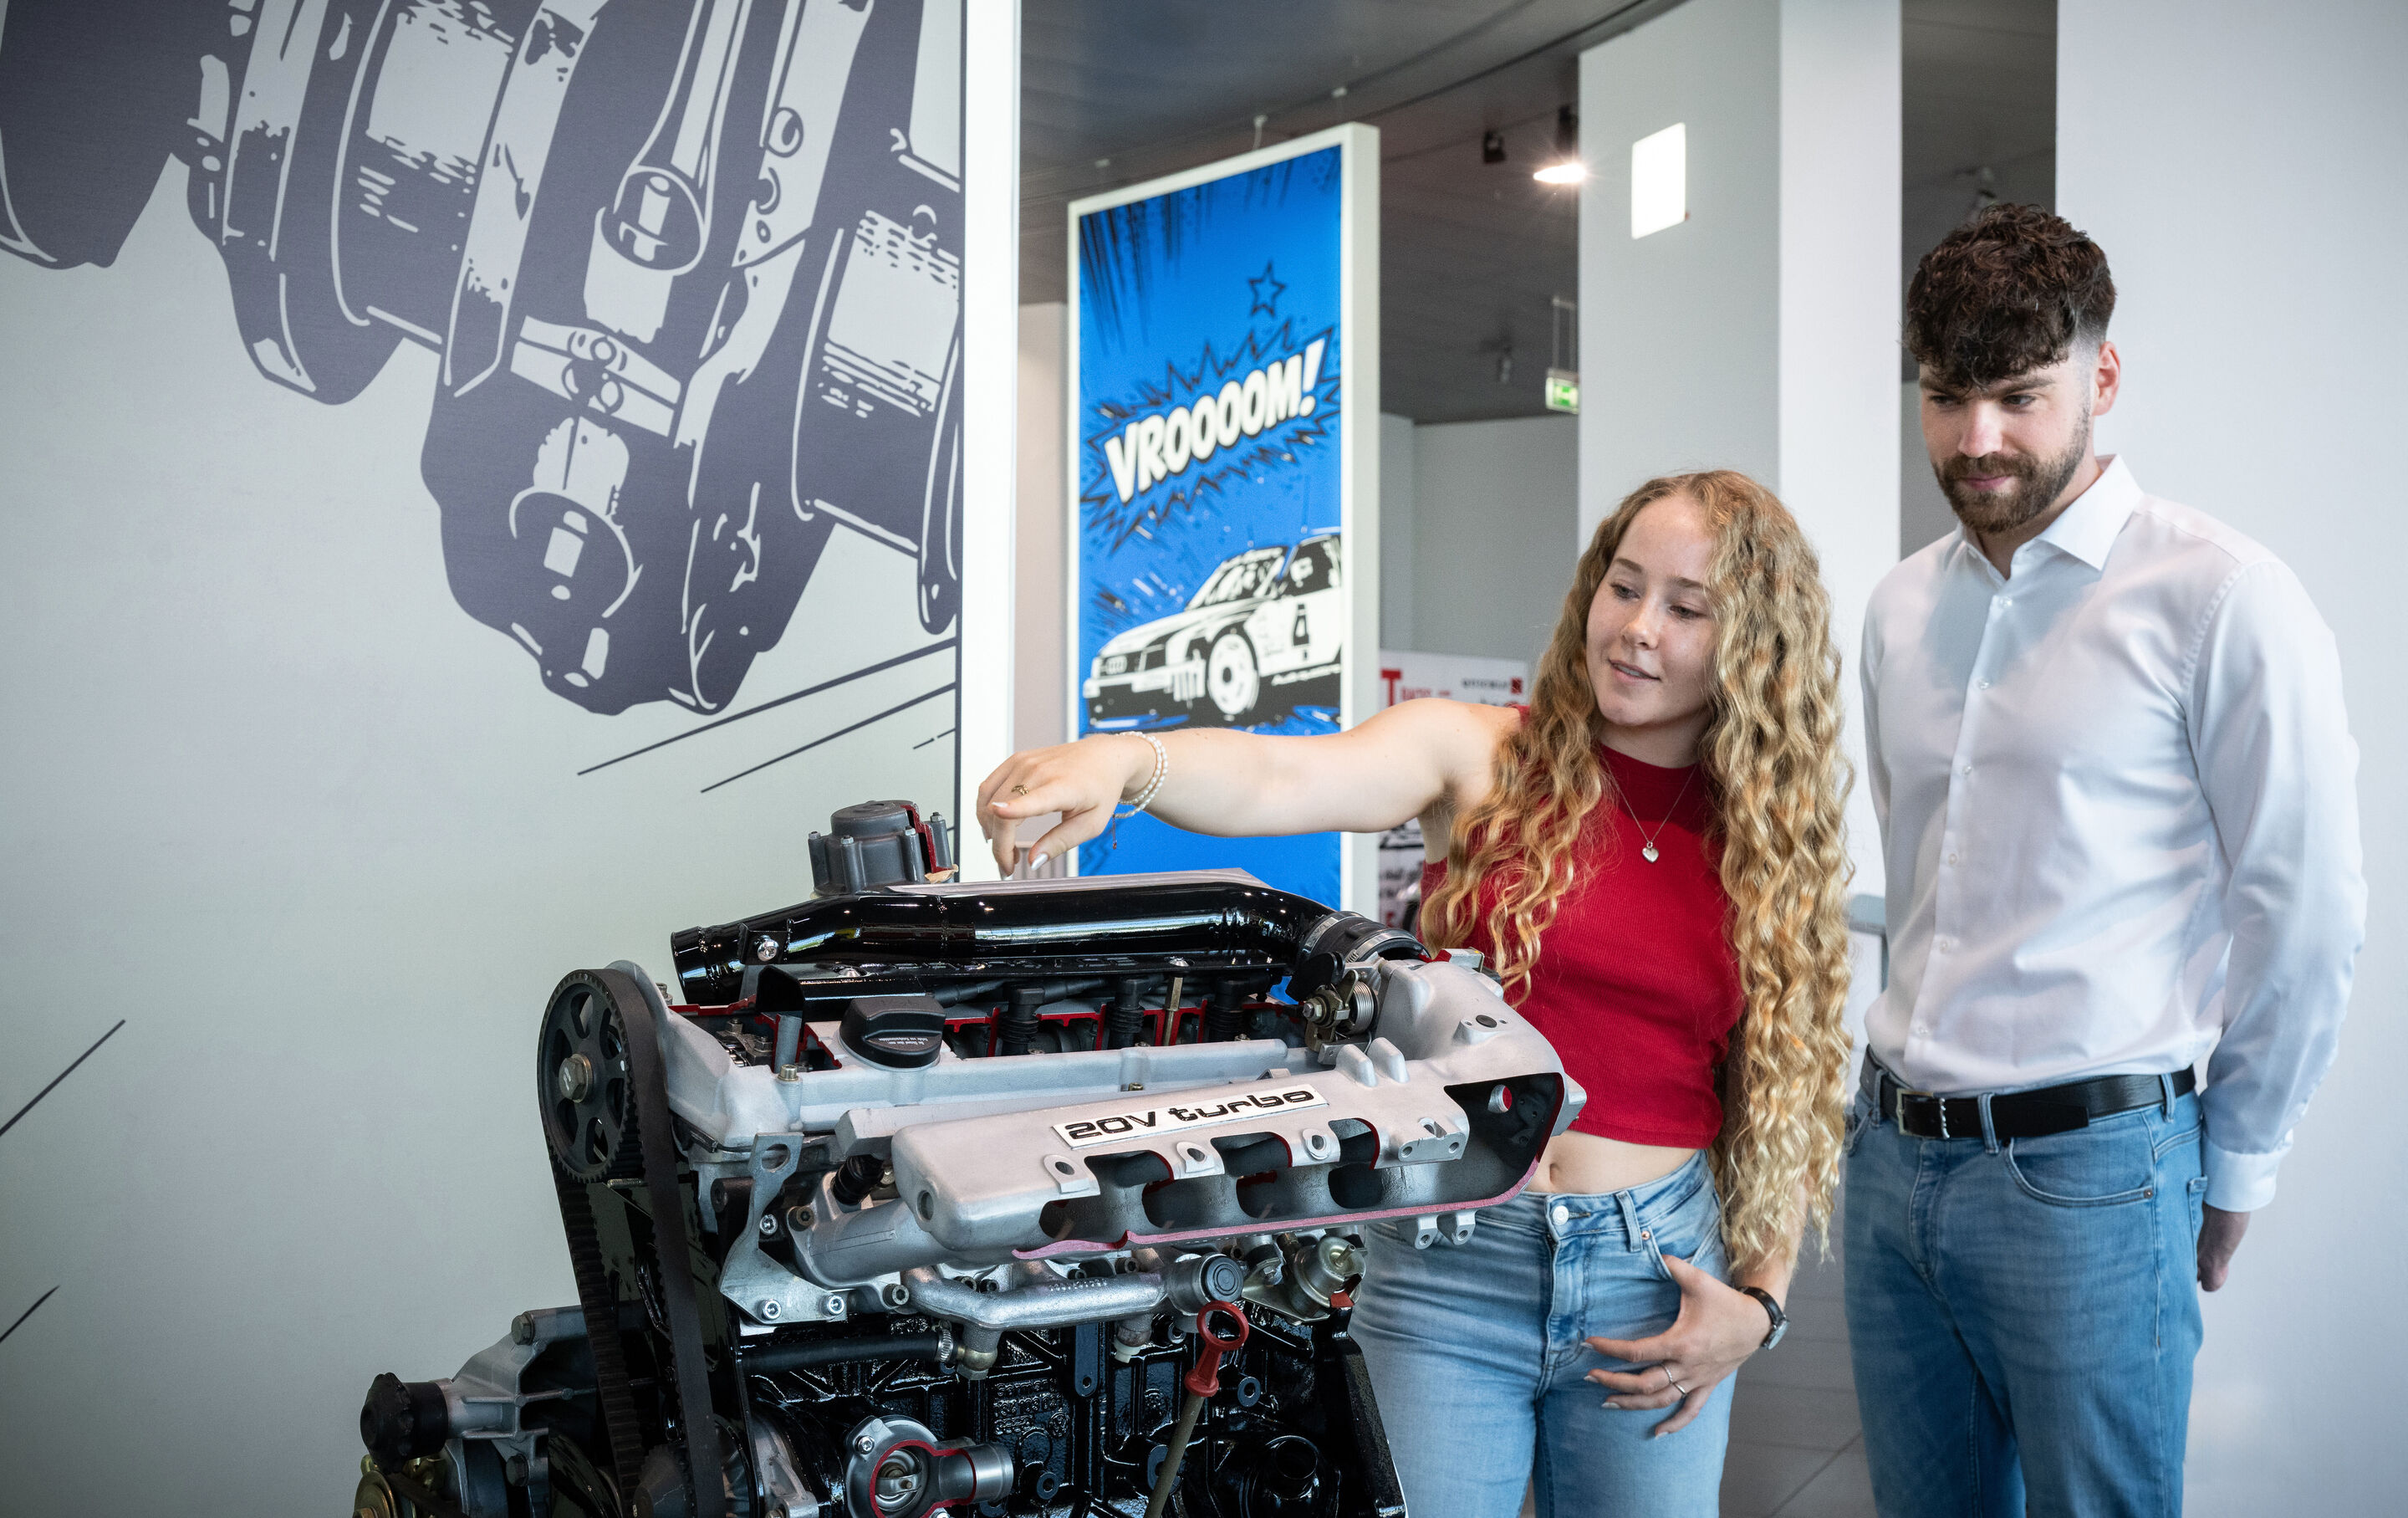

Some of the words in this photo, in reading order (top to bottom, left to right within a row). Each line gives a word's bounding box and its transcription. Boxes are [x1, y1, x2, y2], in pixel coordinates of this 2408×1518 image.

[1105, 337, 1325, 503] VROOOOM!
[1064, 1111, 1156, 1140] 20V
[1168, 1090, 1314, 1122] turbo
